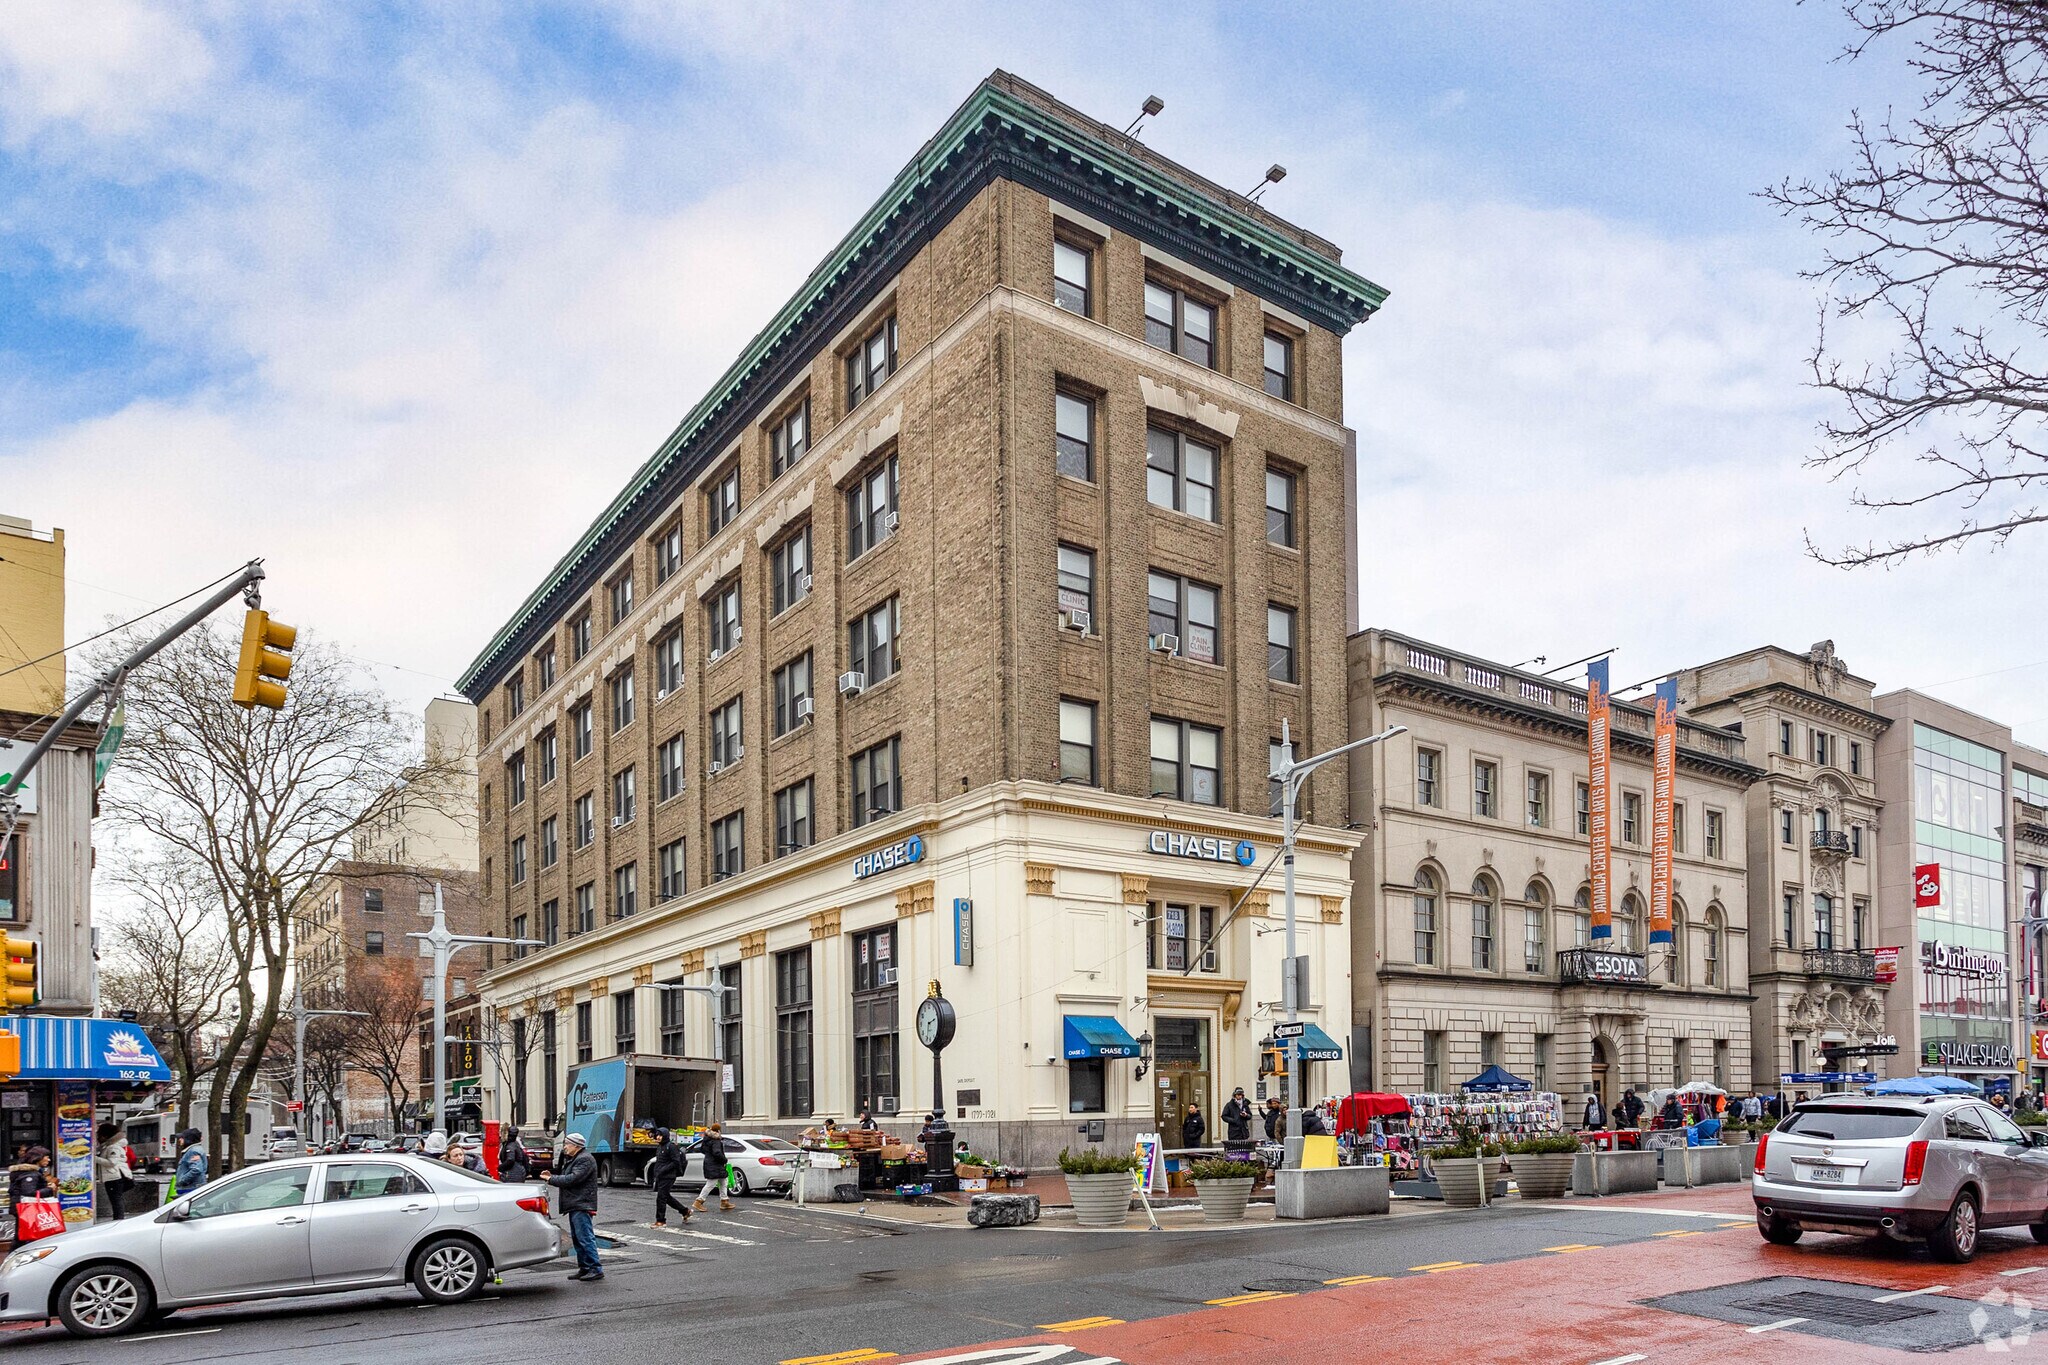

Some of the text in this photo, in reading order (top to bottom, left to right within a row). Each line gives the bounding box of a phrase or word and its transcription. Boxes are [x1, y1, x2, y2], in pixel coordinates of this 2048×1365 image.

[1061, 593, 1085, 606] CLINIC
[1189, 642, 1211, 653] CLINIC
[1192, 635, 1208, 645] PAIN
[1591, 717, 1607, 914] JAMAICA CENTER FOR ARTS AND LEARNING
[1653, 733, 1671, 920] JAMAICA CENTER FOR ARTS AND LEARNING
[1150, 831, 1233, 861] CHASE
[853, 842, 907, 878] CHASE
[961, 913, 970, 951] CHASE
[1594, 955, 1639, 976] ESOTA
[1933, 940, 2004, 979] Burlington
[1100, 1047, 1123, 1055] CHASE
[1307, 1051, 1332, 1059] CHASE
[1940, 1042, 2016, 1067] SHAKE SHACK
[119, 1070, 151, 1080] 162-02
[583, 1091, 608, 1103] Patterson
[37, 1211, 58, 1225] S&A
